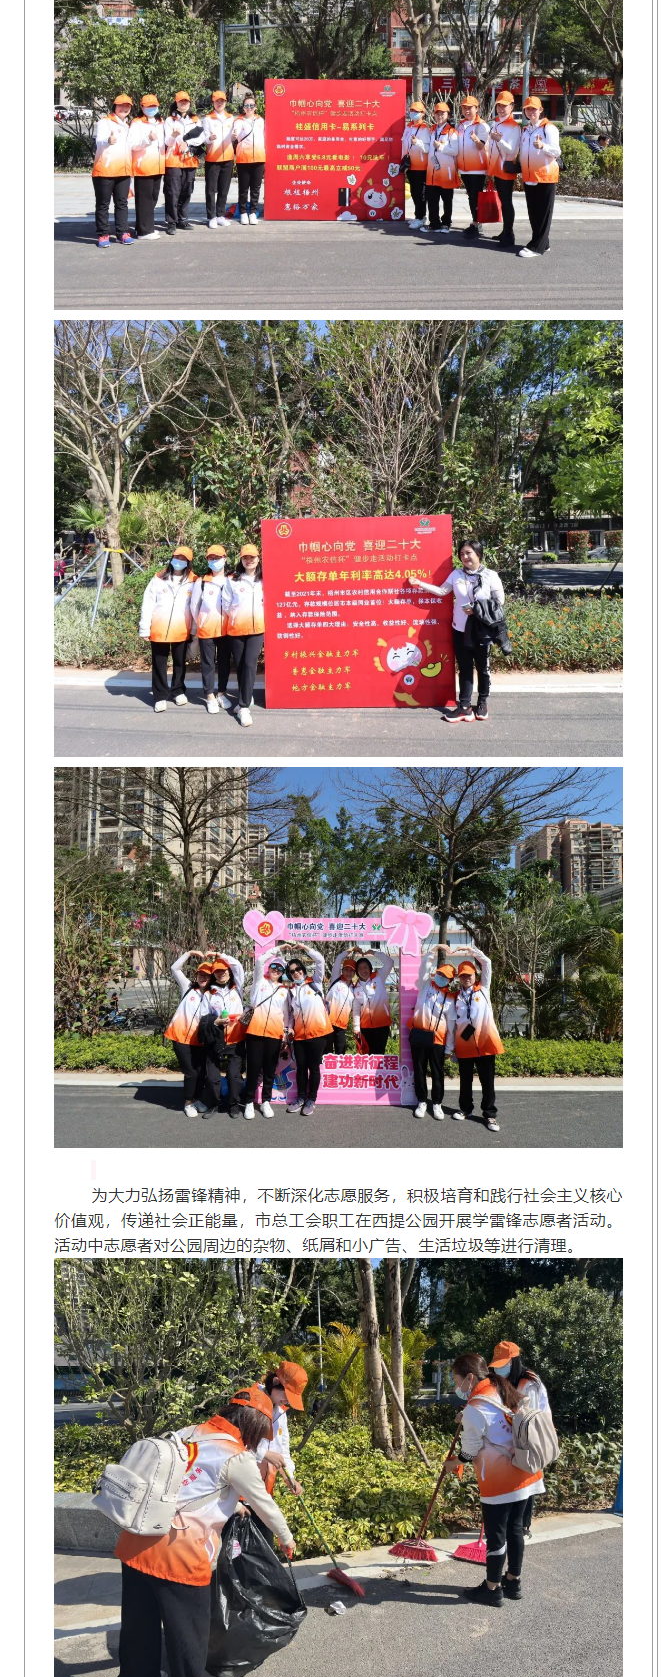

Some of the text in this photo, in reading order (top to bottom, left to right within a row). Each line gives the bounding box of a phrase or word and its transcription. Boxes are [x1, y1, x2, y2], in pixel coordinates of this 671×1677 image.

[289, 99, 381, 108] 巾帼心向党 喜迎二十大
[298, 538, 421, 553] 巾帼心向党 喜迎二十大
[283, 649, 360, 659] 乡村振兴金融主力军
[291, 666, 352, 676] 普惠金融主力军
[291, 682, 352, 692] 地方金融主力军
[287, 922, 366, 931] 巾帼心向党 喜迎二十大
[322, 1053, 399, 1071] 奋进新征程
[322, 1074, 400, 1089] 建功新时代
[91, 1187, 623, 1203] 为大力弘扬雷锋精神，不断深化志愿服务，积极培育和践行社会主义核心
[54, 1212, 613, 1228] 价值观，传递社会正能量，市总工会职工在西提公园开展学雷锋志愿者活动。
[54, 1237, 574, 1254] 活动中志愿者对公园周边的杂物、纸屑和小广告、生活垃圾等进行清理。
